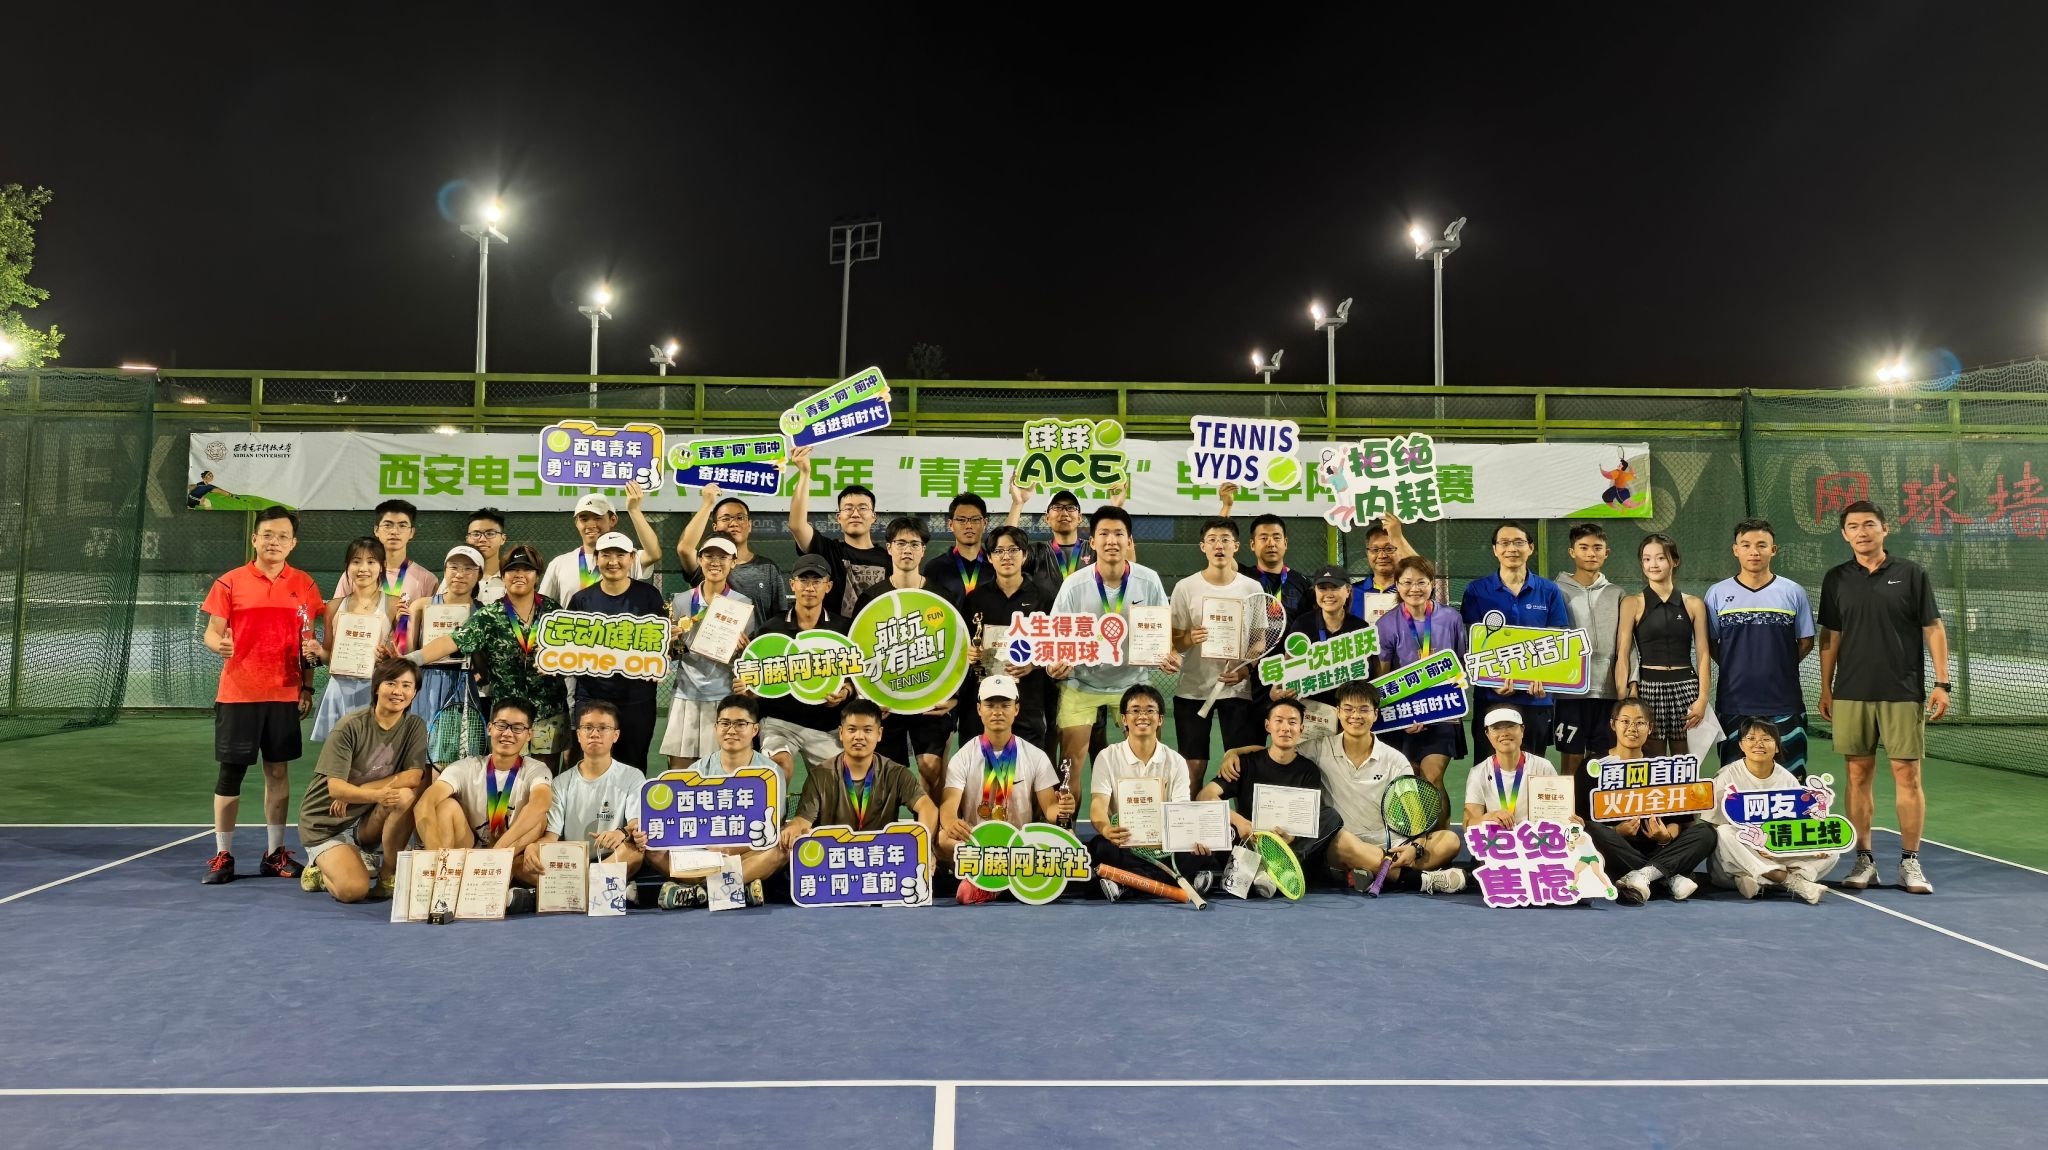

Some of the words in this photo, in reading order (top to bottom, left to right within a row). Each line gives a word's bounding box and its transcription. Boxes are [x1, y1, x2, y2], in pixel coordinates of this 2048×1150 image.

[812, 405, 885, 437] 奋进新时代
[573, 438, 642, 457] 西电青年
[1027, 423, 1091, 453] 球球
[1197, 421, 1294, 452] TENNIS
[698, 441, 780, 460] 青春“网”前冲
[1349, 435, 1434, 478] 拒绝
[547, 458, 634, 480] 勇“网”直前
[699, 466, 775, 487] 奋进新时代
[1020, 452, 1122, 484] ACE
[1194, 451, 1259, 482] YYDS
[1354, 478, 1441, 524] 内耗
[927, 610, 944, 621] FUN
[1009, 615, 1095, 638] 人生得意
[1209, 614, 1234, 622] 荣誉证书
[543, 616, 665, 652] 运动健康
[1034, 640, 1100, 662] 须网球
[1261, 628, 1379, 683] 每一次跳跃
[1466, 629, 1591, 681] 无界活力
[737, 646, 864, 687] 青藤网球社
[889, 670, 931, 692] TENNIS
[1381, 692, 1462, 722] 奋进新时代
[1555, 722, 1578, 743] 47
[1602, 758, 1698, 789] 勇网直前
[677, 788, 754, 813] 西电青年
[1126, 796, 1153, 804] 荣誉证书
[1537, 793, 1565, 801] 荣誉证书
[1603, 786, 1687, 816] 火力全开
[1743, 793, 1797, 820] 网友
[647, 814, 746, 840] 勇“网”直前
[1468, 821, 1569, 860] 拒绝
[1768, 821, 1842, 848] 请上线
[549, 861, 577, 869] 荣誉证书
[828, 845, 905, 869] 西电青年
[957, 845, 1090, 878] 青藤网球社
[473, 868, 502, 877] 荣誉证书
[800, 871, 897, 897] 勇“网”直前
[1476, 864, 1580, 905] 焦虑
